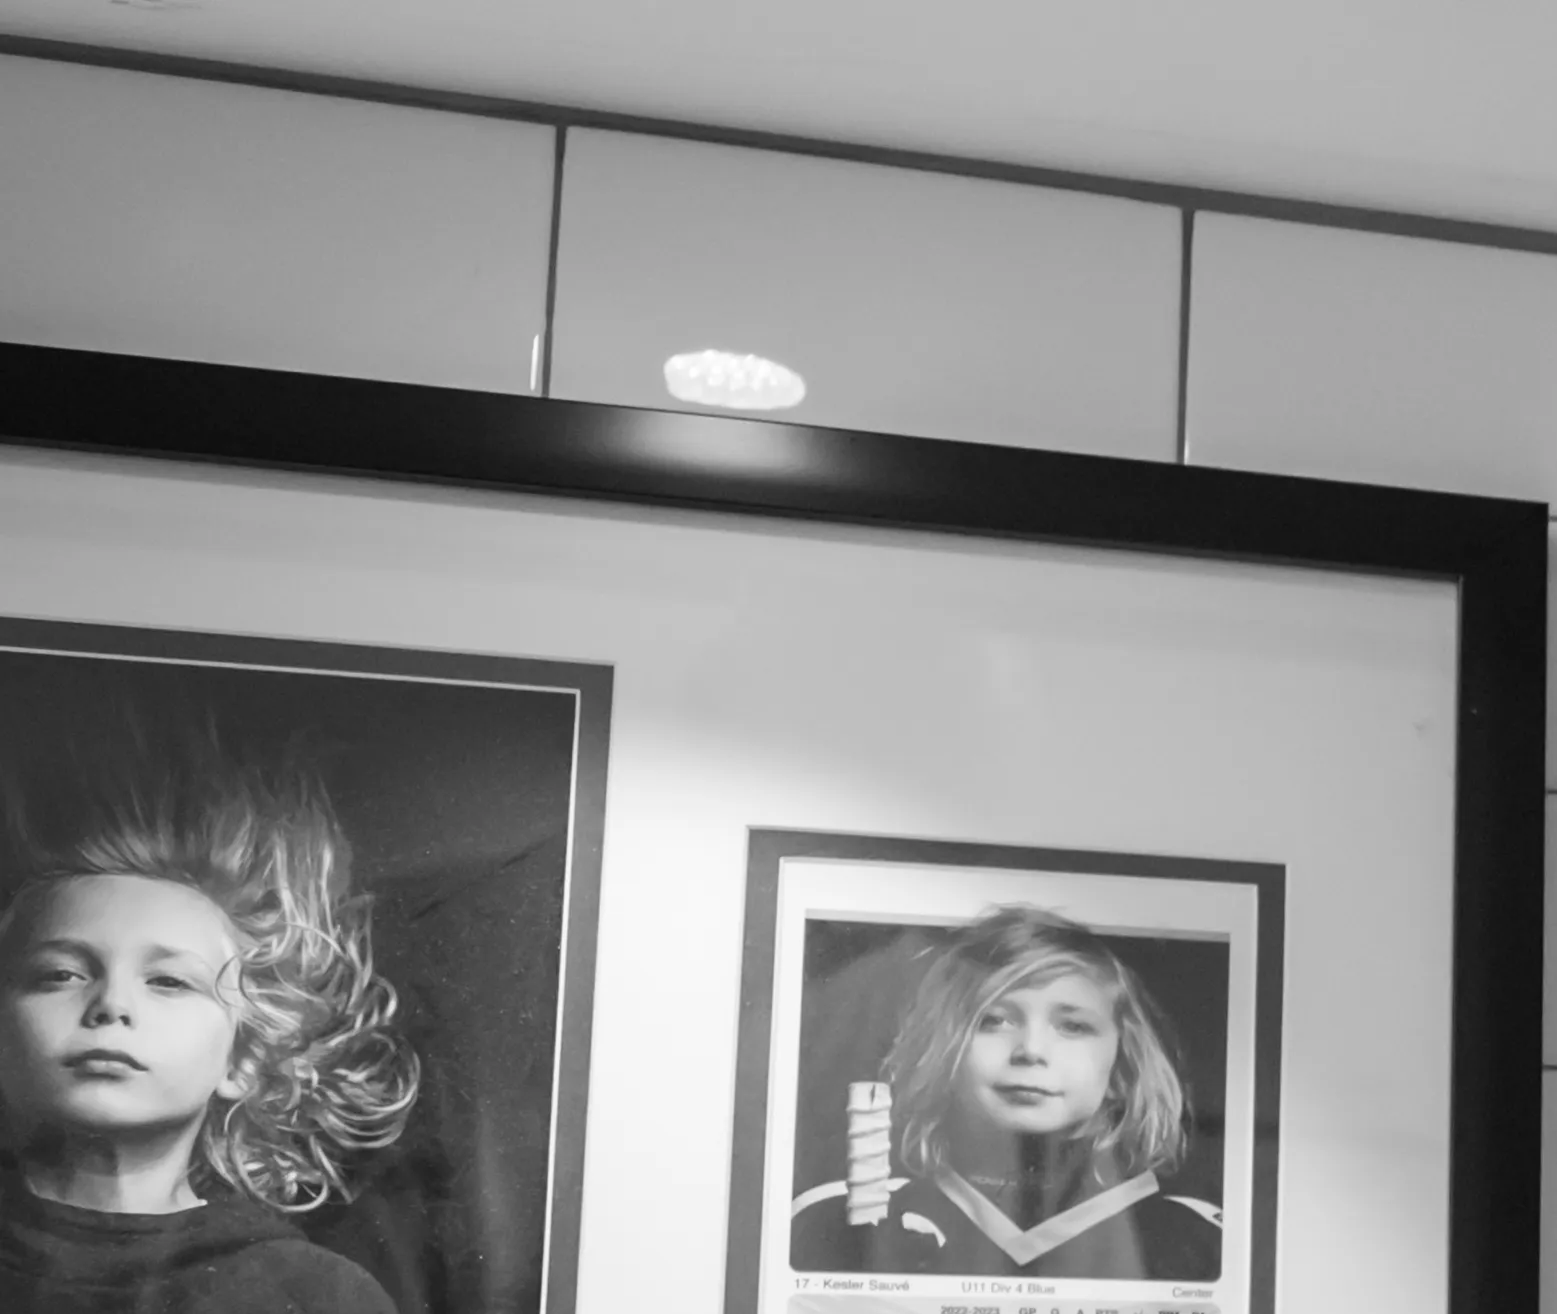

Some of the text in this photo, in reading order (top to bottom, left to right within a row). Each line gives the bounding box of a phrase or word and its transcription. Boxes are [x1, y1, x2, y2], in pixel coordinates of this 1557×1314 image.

[795, 1279, 810, 1289] 17
[823, 1279, 864, 1290] Kesler
[869, 1279, 910, 1291] Sauvé
[991, 1282, 1012, 1294] Div
[1027, 1283, 1056, 1294] Blue
[1172, 1287, 1214, 1299] Center
